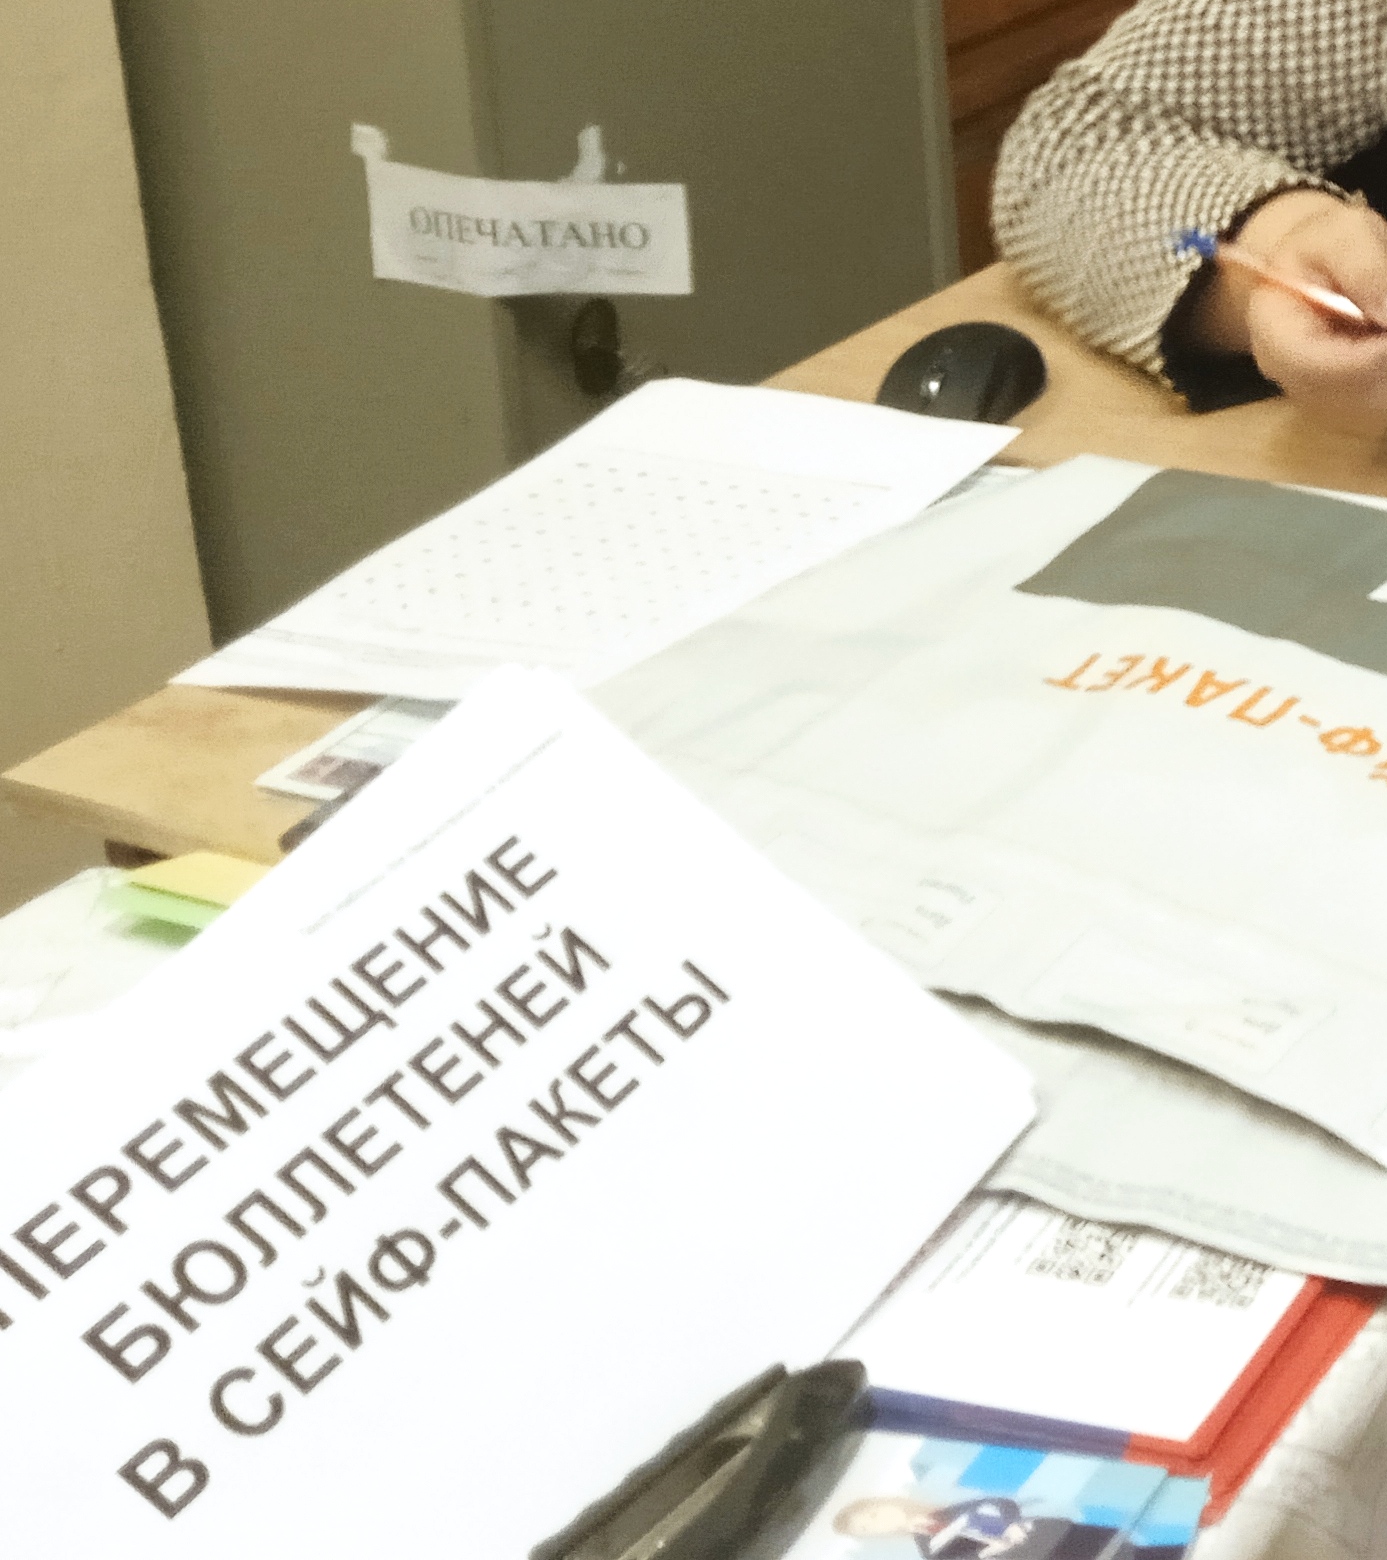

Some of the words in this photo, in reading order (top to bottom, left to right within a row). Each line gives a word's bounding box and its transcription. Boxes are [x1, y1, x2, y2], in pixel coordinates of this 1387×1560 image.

[408, 205, 652, 251] ОПЕЧАТАНО
[81, 925, 612, 1385] БЮЛЛЕТЕНЕЙ
[116, 1437, 211, 1521] В
[208, 959, 731, 1438] СЕЙФ-ПАКЕТЫ
